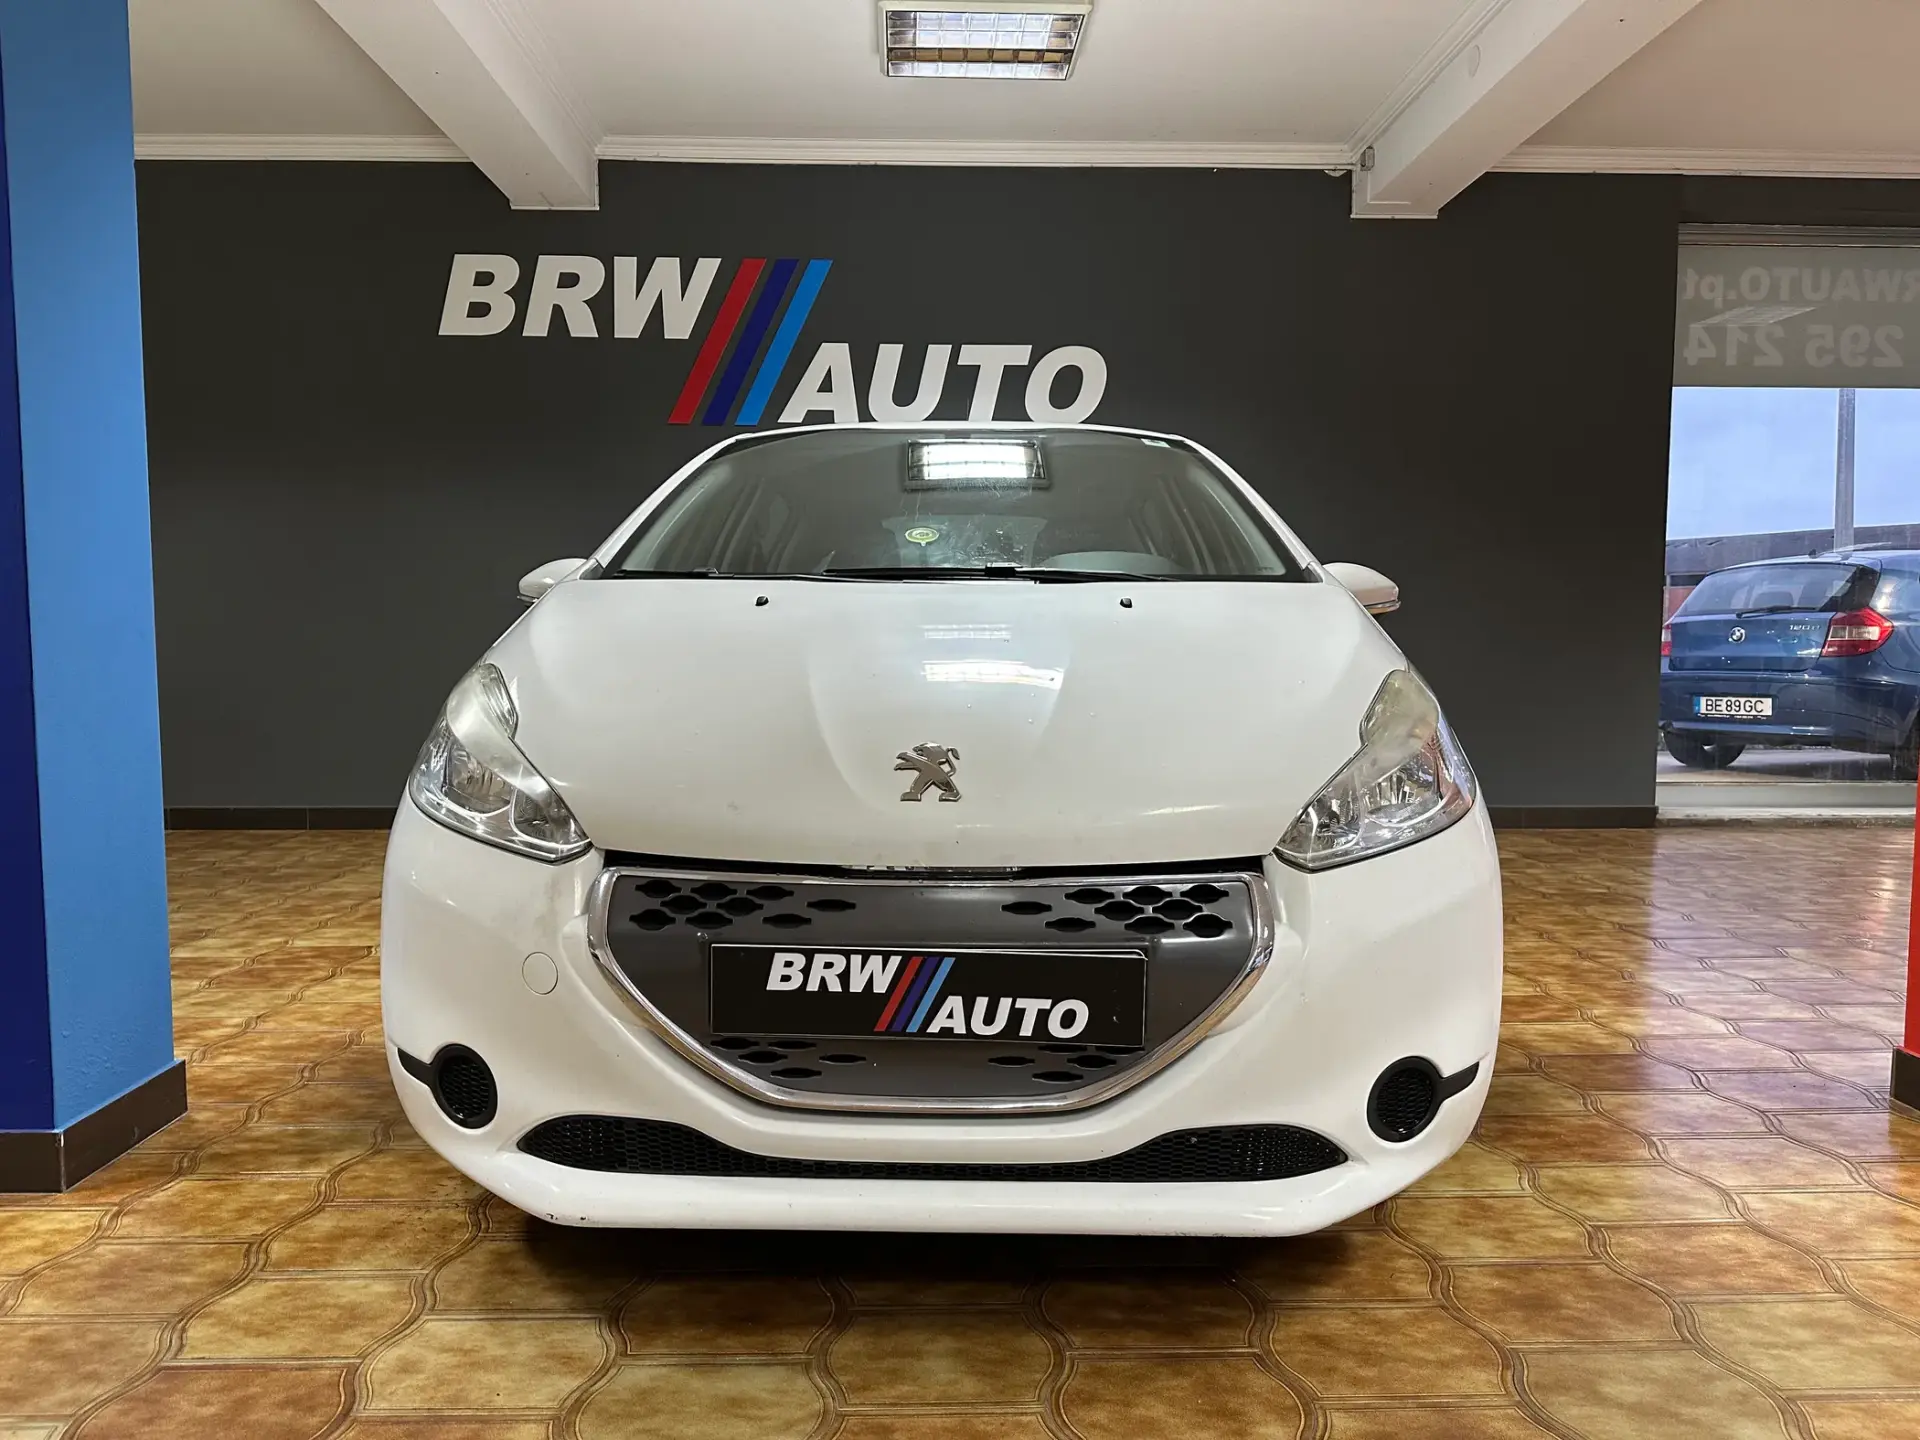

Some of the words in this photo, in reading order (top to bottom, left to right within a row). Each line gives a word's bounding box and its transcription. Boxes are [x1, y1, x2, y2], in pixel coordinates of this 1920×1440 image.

[439, 254, 722, 339] BRW
[777, 343, 1108, 424] AUTO
[1705, 698, 1723, 712] BE
[1725, 699, 1741, 713] 89
[1743, 699, 1764, 713] GC
[766, 953, 902, 993] BRW
[927, 996, 1089, 1038] AUTO
